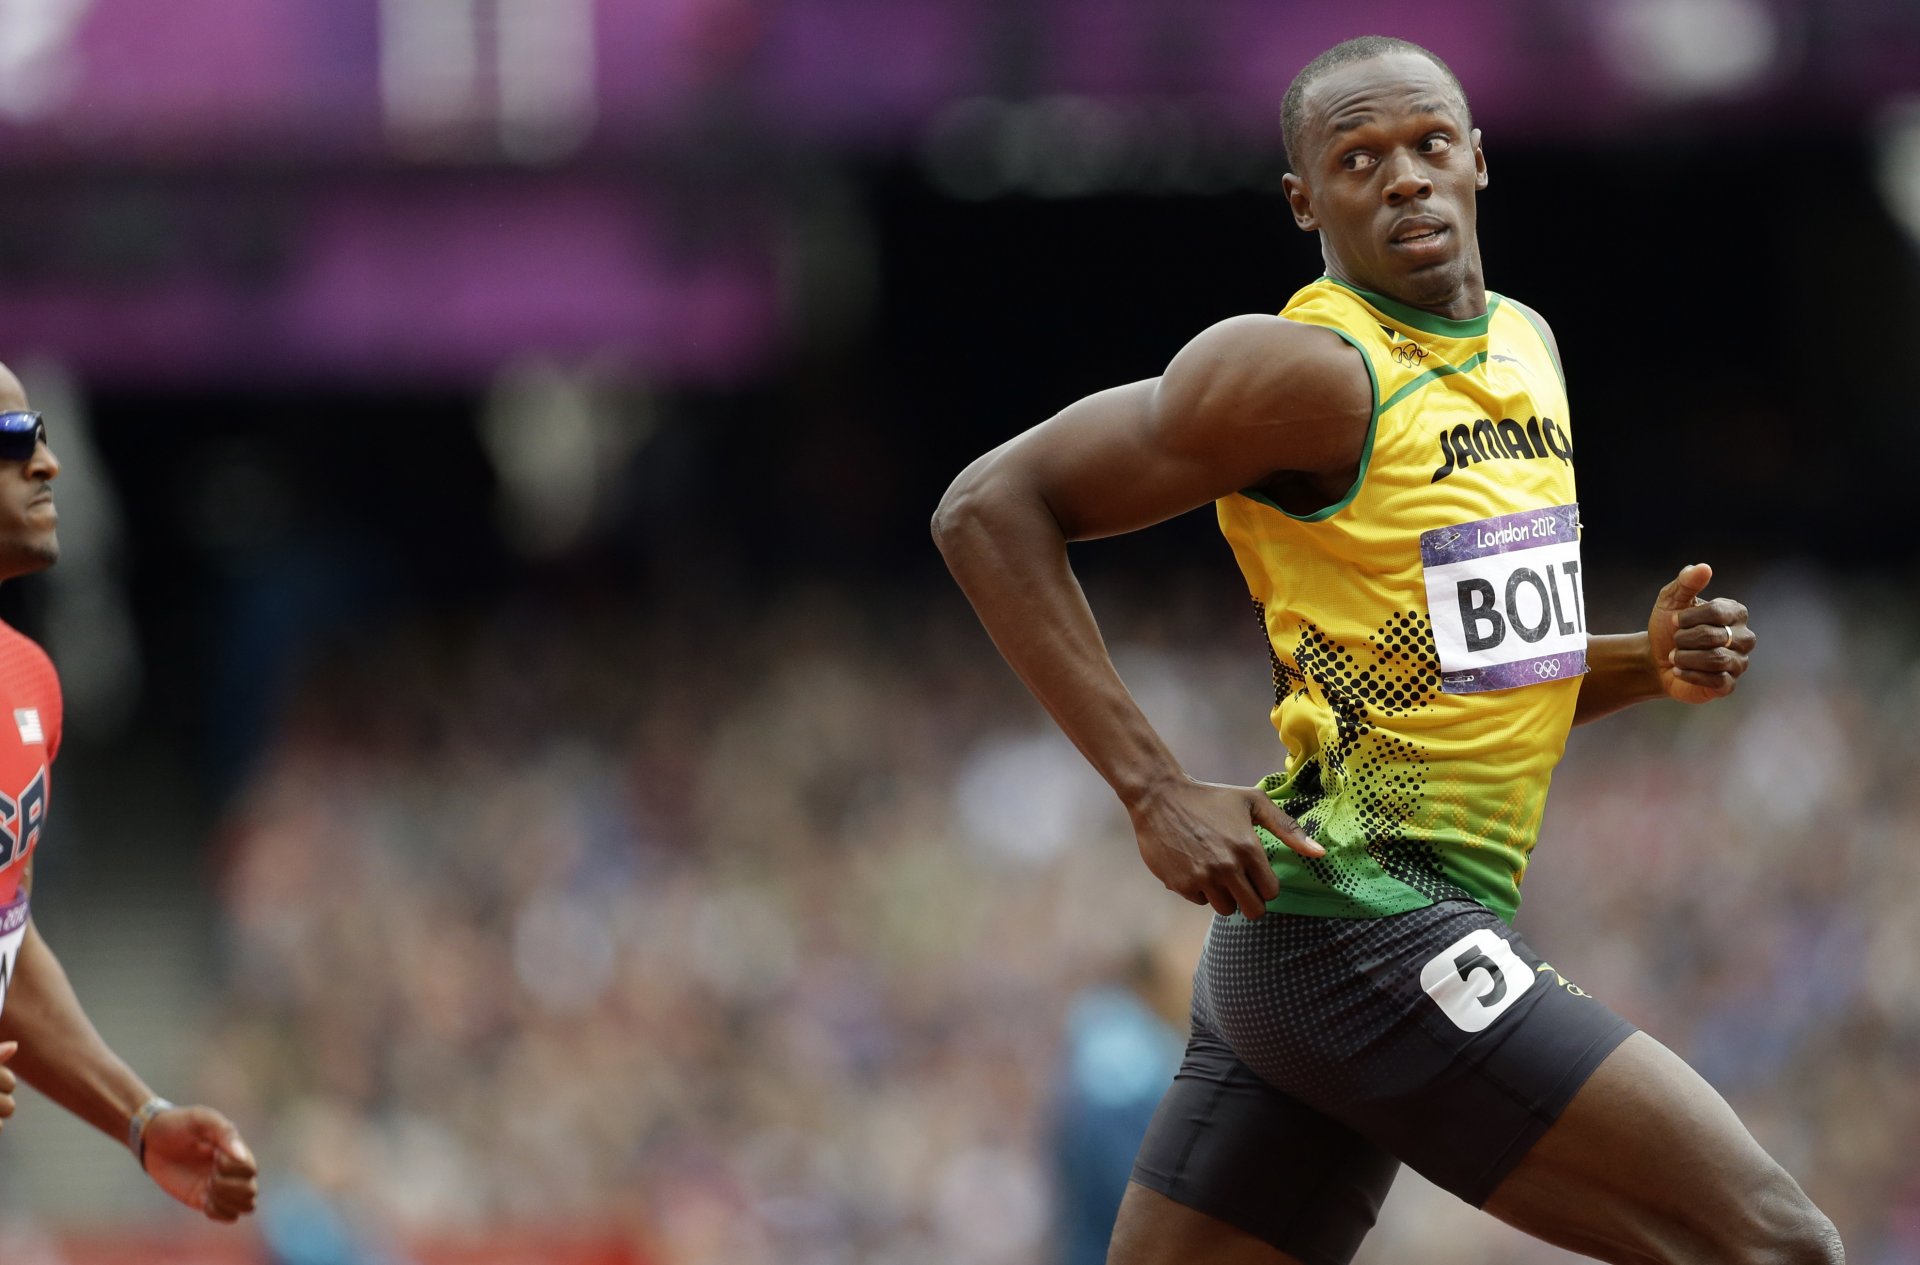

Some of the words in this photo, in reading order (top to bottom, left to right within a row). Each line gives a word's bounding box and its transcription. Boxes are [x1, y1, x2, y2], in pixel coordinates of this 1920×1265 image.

[1477, 522, 1530, 549] London
[1530, 516, 1557, 538] 2012
[1457, 560, 1583, 653] BOLT
[1453, 944, 1508, 1008] 5
